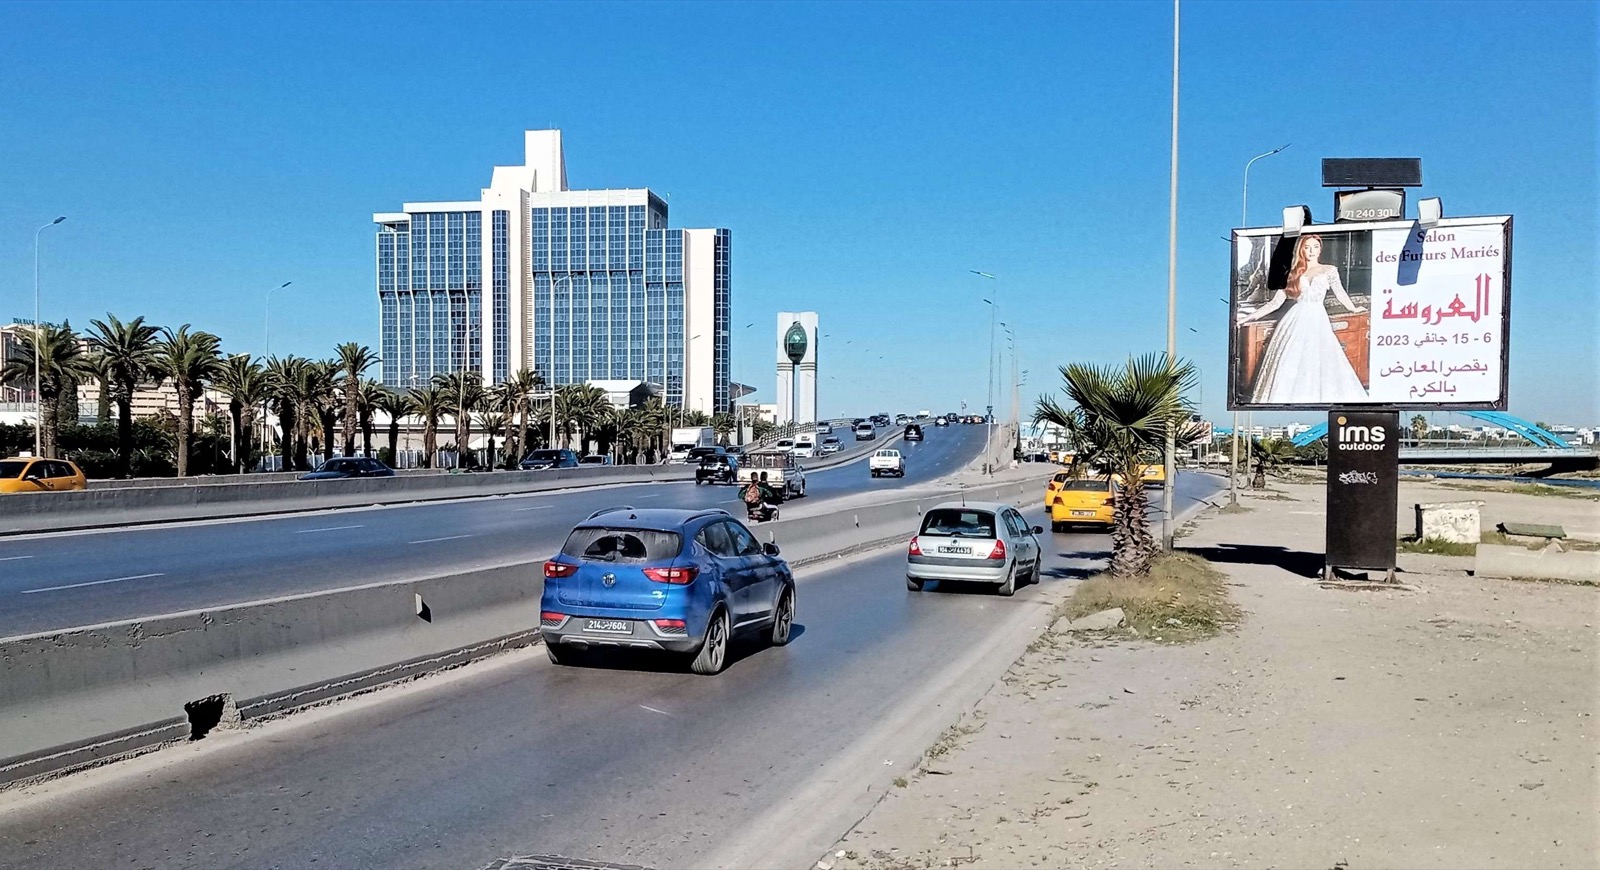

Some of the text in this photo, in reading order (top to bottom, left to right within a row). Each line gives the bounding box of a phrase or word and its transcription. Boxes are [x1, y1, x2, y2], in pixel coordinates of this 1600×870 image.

[1356, 209, 1375, 218] 240
[1377, 208, 1393, 218] 301
[1416, 230, 1456, 244] Salon
[1375, 245, 1500, 263] des Futurs Mariés
[1383, 273, 1492, 326] العروسة
[1377, 335, 1410, 346] 2023
[1414, 333, 1448, 348] جانفي
[1452, 333, 1470, 345] 15
[1483, 332, 1492, 344] 6
[1409, 380, 1457, 399] بالكرم
[1337, 415, 1386, 442] ims
[1339, 442, 1385, 451] outdoor
